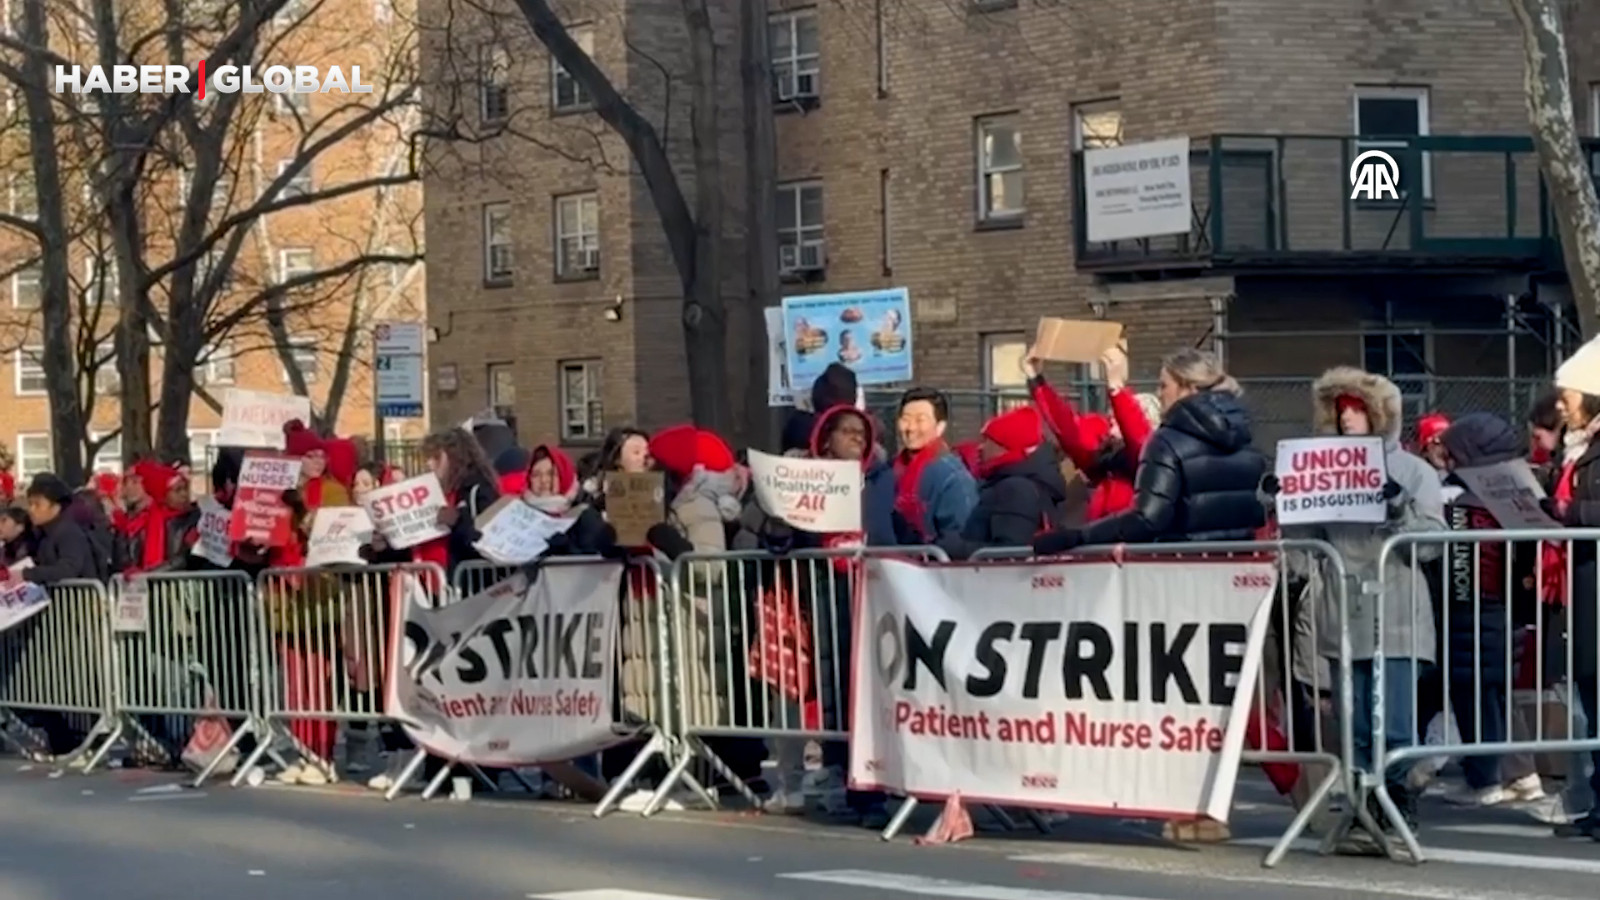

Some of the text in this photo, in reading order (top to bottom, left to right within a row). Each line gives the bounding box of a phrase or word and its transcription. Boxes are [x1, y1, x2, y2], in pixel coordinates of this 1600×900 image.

[248, 460, 290, 474] MORE
[1292, 446, 1368, 473] UNION
[241, 472, 296, 487] NURSES
[765, 473, 851, 496] Healthcare
[775, 464, 836, 482] Quality
[1282, 468, 1382, 496] BUSTING
[371, 485, 430, 520] STOP
[795, 493, 826, 511] All
[1283, 491, 1385, 512] IS DISGUSTING
[876, 611, 1247, 707] ON STRIKE
[556, 688, 601, 723] Safety
[894, 701, 991, 741] Patient
[997, 711, 1056, 745] and
[1065, 711, 1153, 750] Nurse
[1159, 714, 1226, 754] Safe
